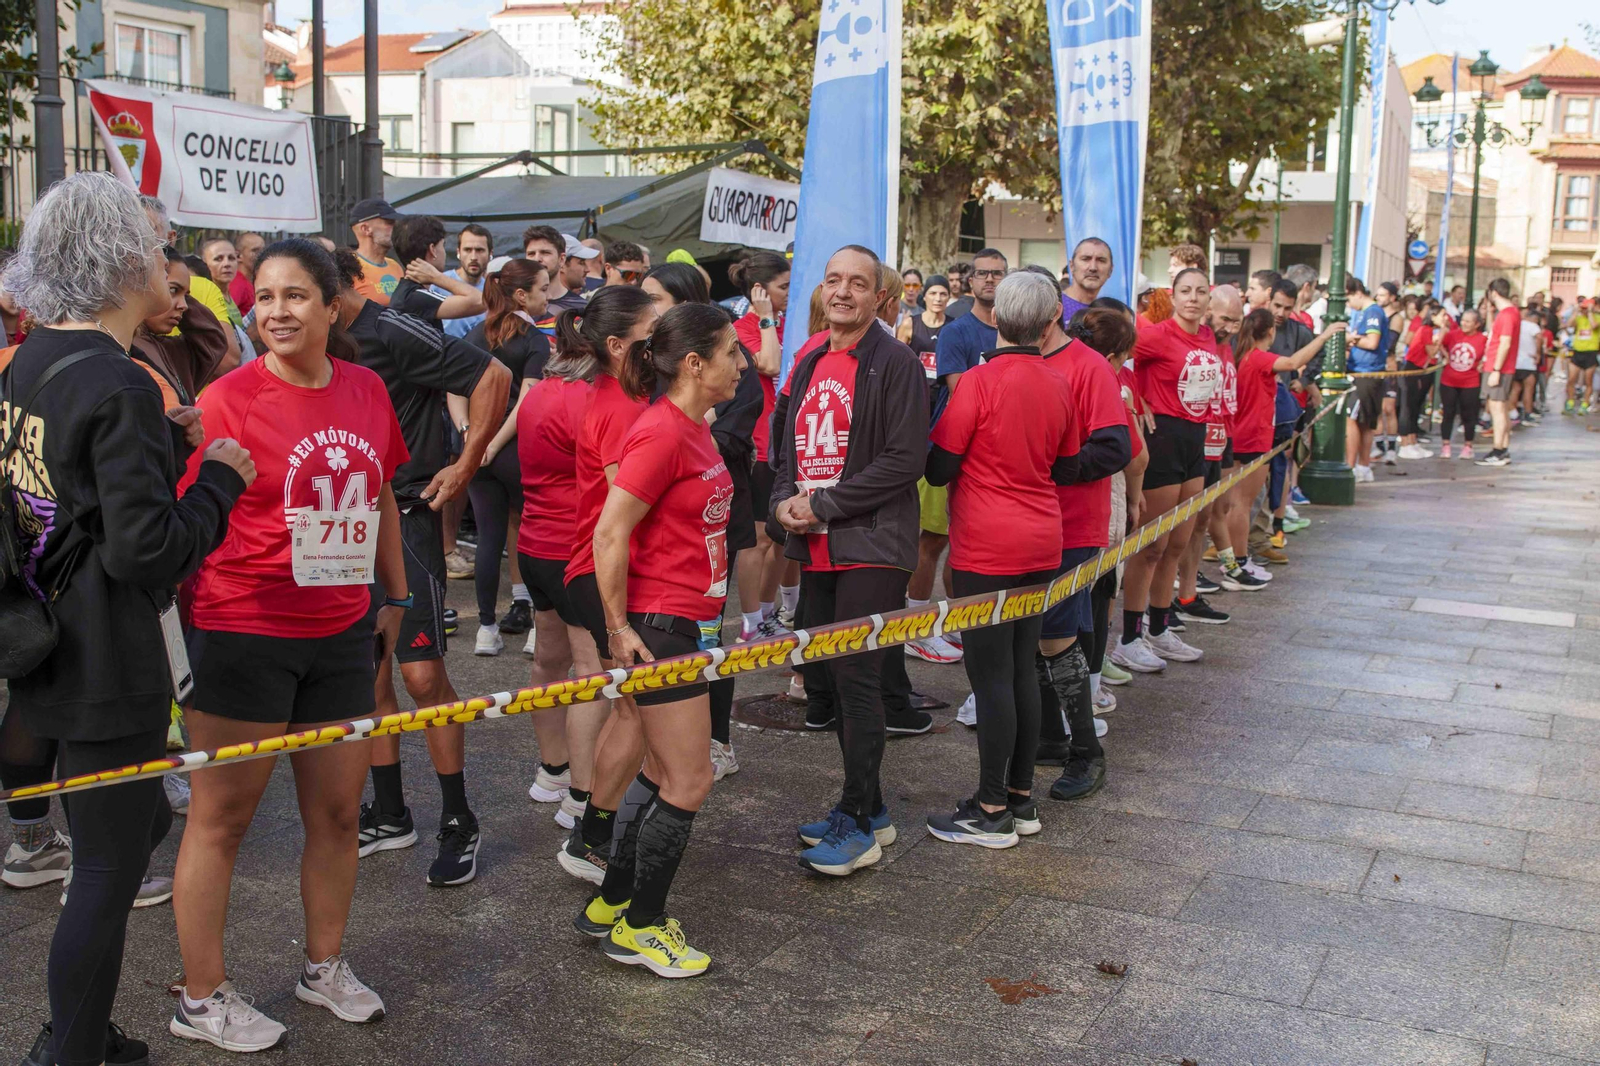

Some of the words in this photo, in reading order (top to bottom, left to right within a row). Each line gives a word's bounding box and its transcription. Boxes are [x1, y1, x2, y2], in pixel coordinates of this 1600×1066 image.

[184, 132, 296, 166] CONCELLO
[199, 167, 227, 193] DE
[236, 170, 285, 197] VIGO
[1199, 368, 1217, 382] 558
[818, 377, 851, 405] MÓVOME
[287, 436, 315, 468] #EU
[313, 426, 377, 462] MÓVOME
[805, 410, 839, 457] 14
[807, 467, 835, 476] MÚLTIPLE
[813, 457, 845, 467] ESCLEROSE
[312, 471, 371, 511] 14
[319, 520, 368, 545] 718
[944, 600, 995, 632] GADIS
[1001, 590, 1046, 621] GADIS
[804, 624, 872, 660] GADIS
[879, 610, 937, 646] GADIS
[719, 638, 795, 676] GADIS
[584, 852, 608, 872] HOKA
[645, 936, 678, 966] ATOM
